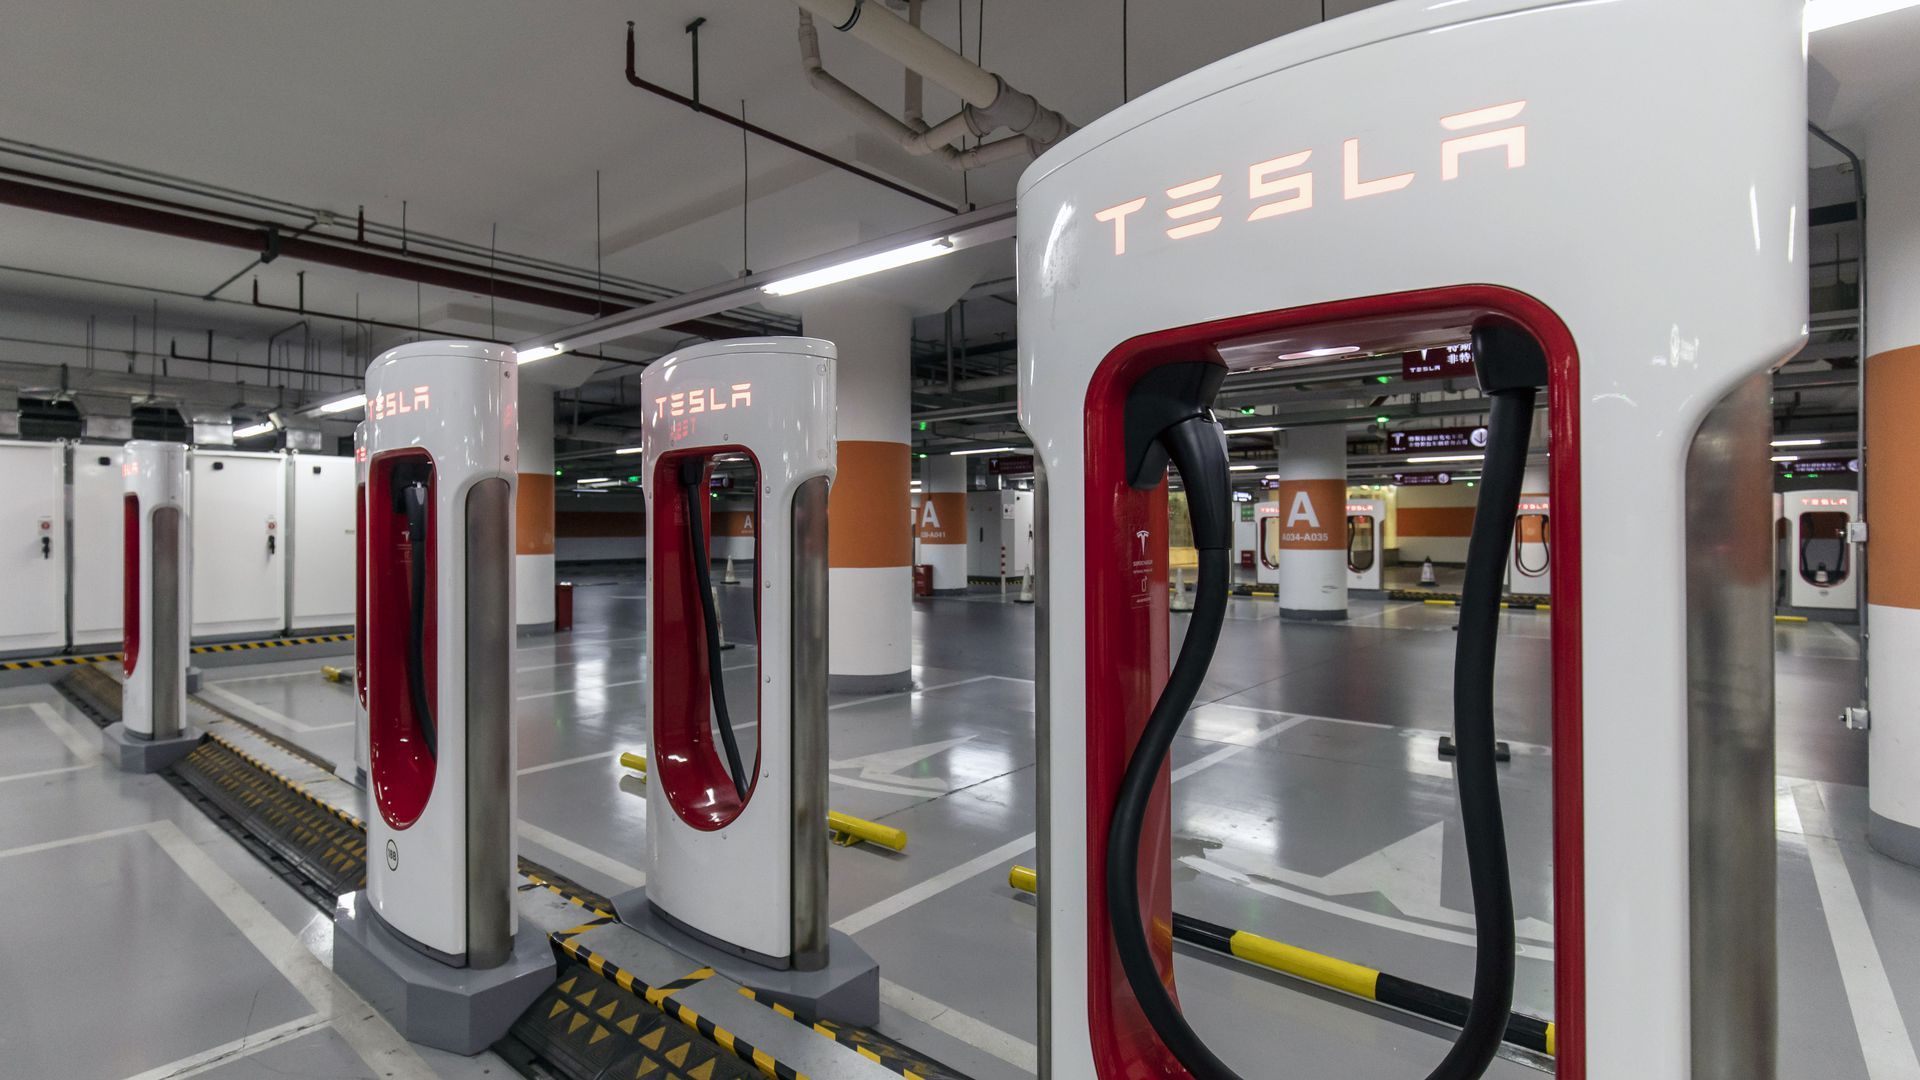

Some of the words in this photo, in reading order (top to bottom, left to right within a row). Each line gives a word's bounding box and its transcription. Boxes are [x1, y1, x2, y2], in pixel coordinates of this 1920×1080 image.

[1094, 99, 1527, 256] TESLA
[1409, 364, 1441, 374] TESLA
[368, 385, 430, 421] TESLA
[655, 383, 752, 419] TESLA
[921, 500, 941, 529] A
[1286, 491, 1321, 528] A
[1801, 498, 1848, 506] TESLA
[1282, 532, 1329, 542] A034-A035
